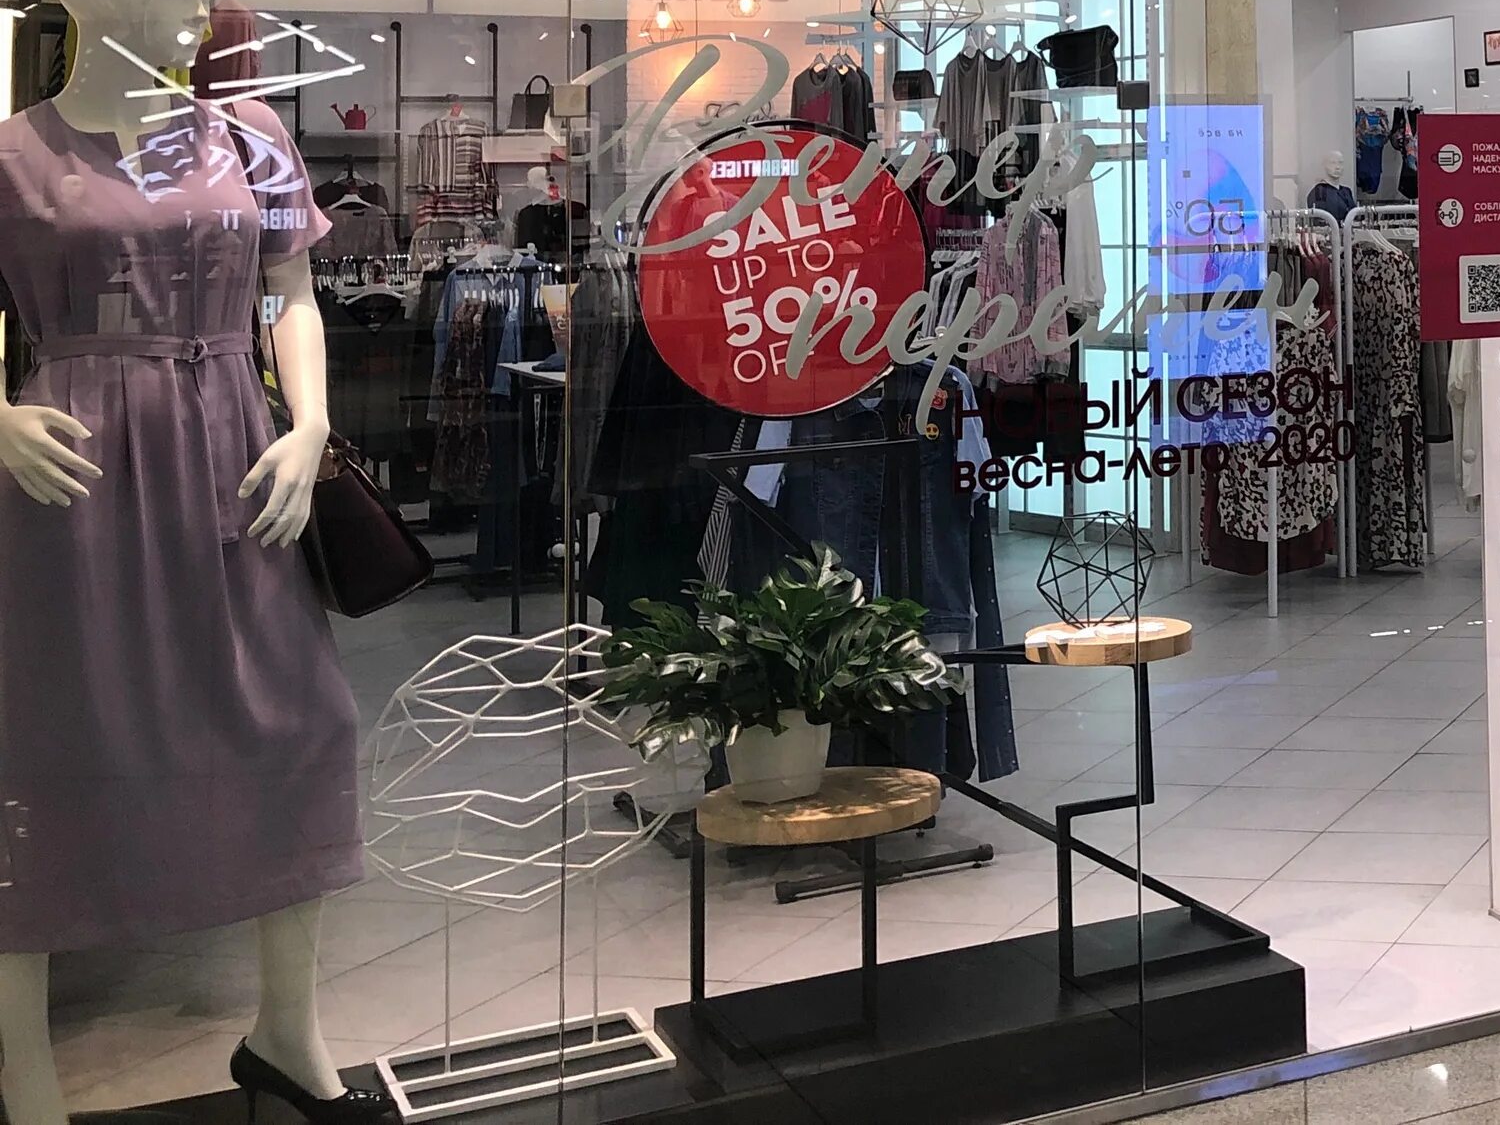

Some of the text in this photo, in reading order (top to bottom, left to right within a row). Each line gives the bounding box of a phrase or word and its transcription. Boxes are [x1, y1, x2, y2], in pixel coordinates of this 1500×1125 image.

[566, 33, 1113, 265] Ветер
[703, 183, 857, 259] SALE
[713, 239, 835, 295] UP TO
[722, 268, 878, 348] 50%
[784, 270, 1332, 435] перемен
[954, 363, 1355, 441] НОВЫЙ СЕЗОН
[954, 419, 1358, 494] весна-лето 2020
